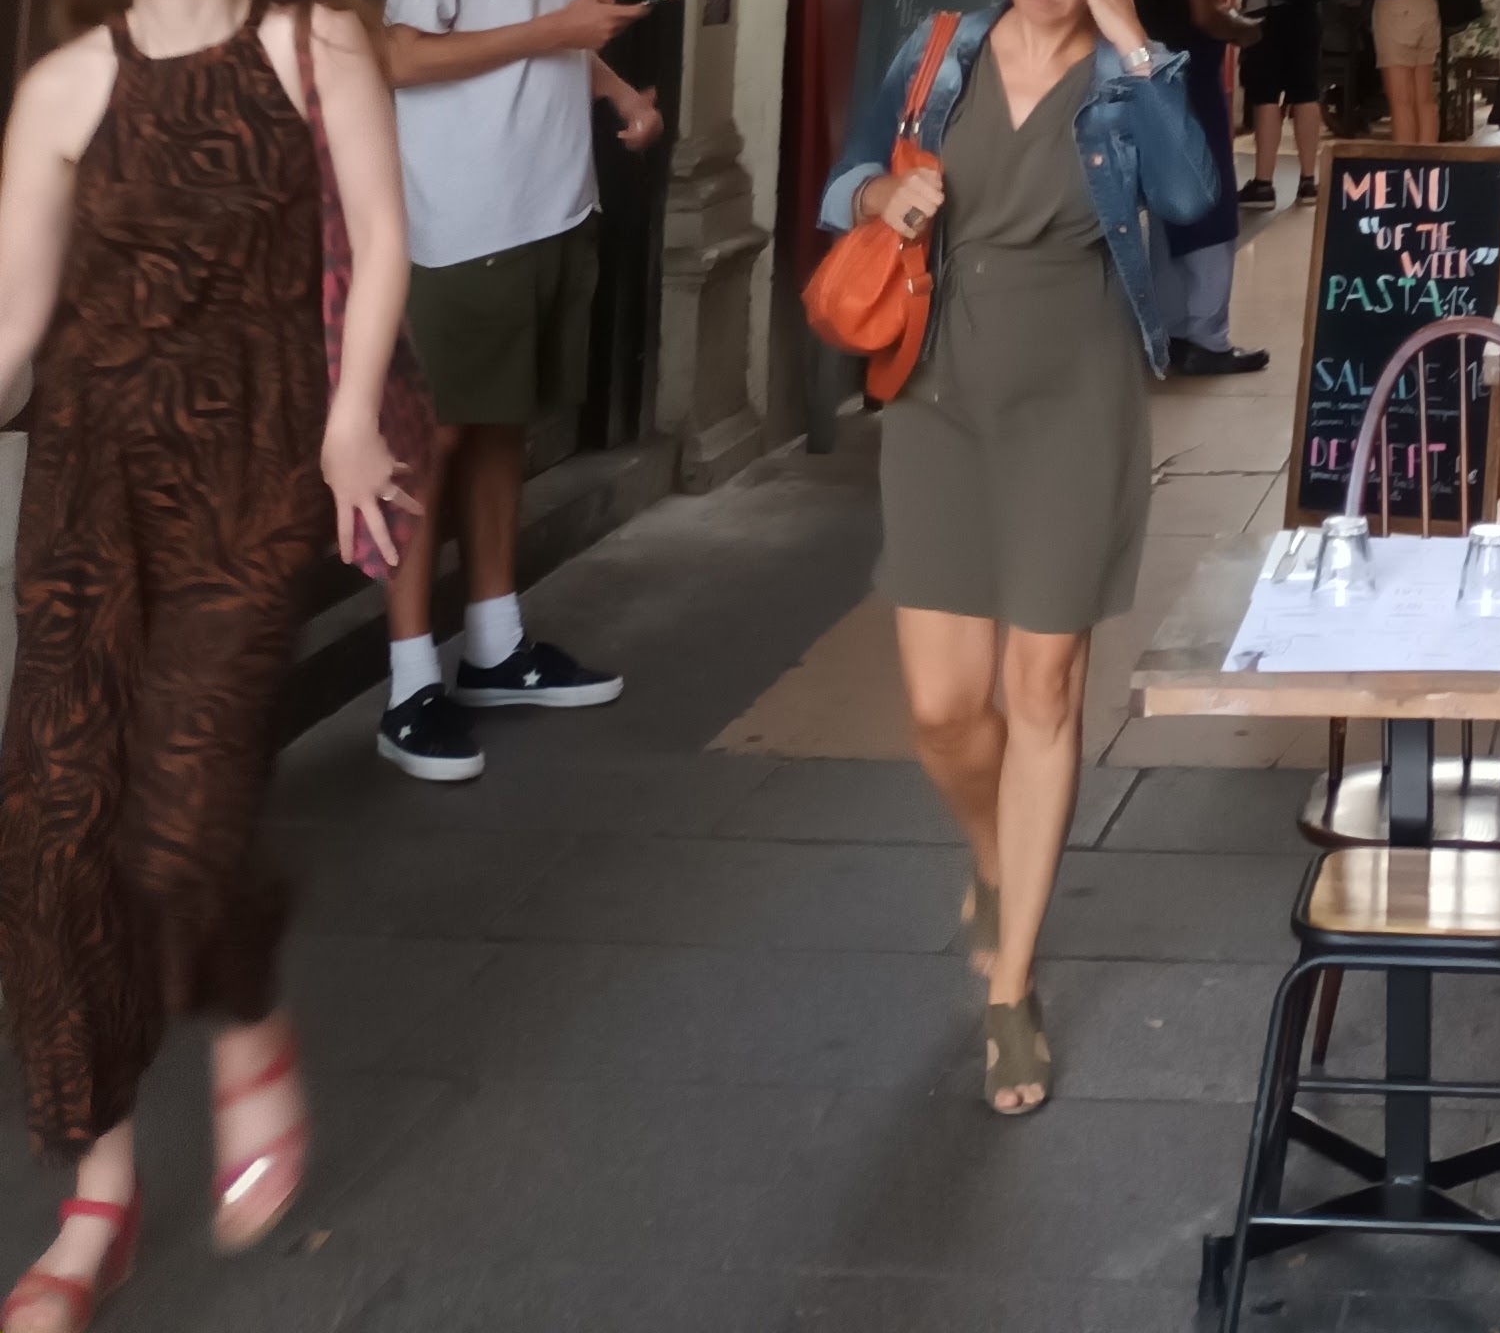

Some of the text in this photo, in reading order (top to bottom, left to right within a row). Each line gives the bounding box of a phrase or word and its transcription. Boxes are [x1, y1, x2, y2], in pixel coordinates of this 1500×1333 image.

[1341, 166, 1450, 213] MENU
[1415, 221, 1457, 252] THE
[1314, 357, 1442, 401] SALDE
